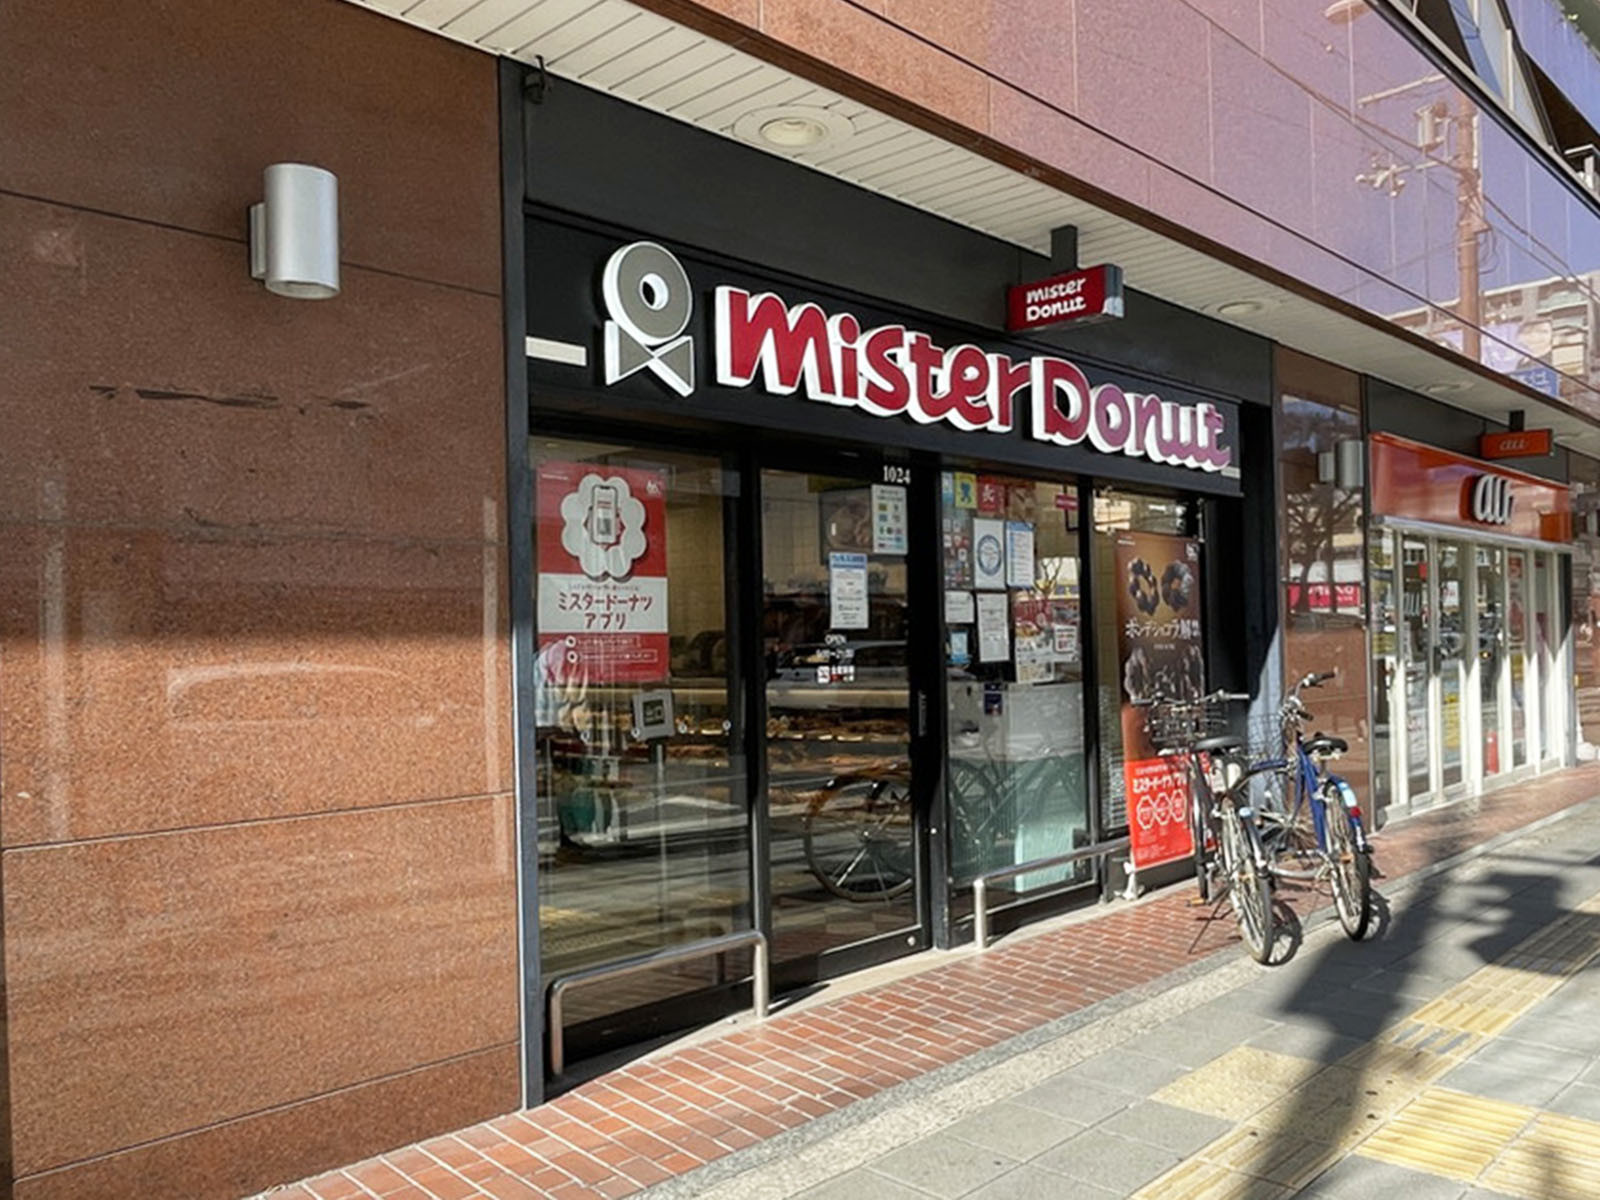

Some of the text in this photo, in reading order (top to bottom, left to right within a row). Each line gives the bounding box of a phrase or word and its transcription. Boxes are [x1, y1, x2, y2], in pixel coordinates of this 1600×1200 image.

[1026, 296, 1087, 322] Donut
[1029, 355, 1231, 472] Donut
[883, 465, 911, 484] 1024
[1473, 474, 1515, 524] au
[558, 592, 653, 612] ミスタードーナツ
[584, 612, 627, 630] アプリ
